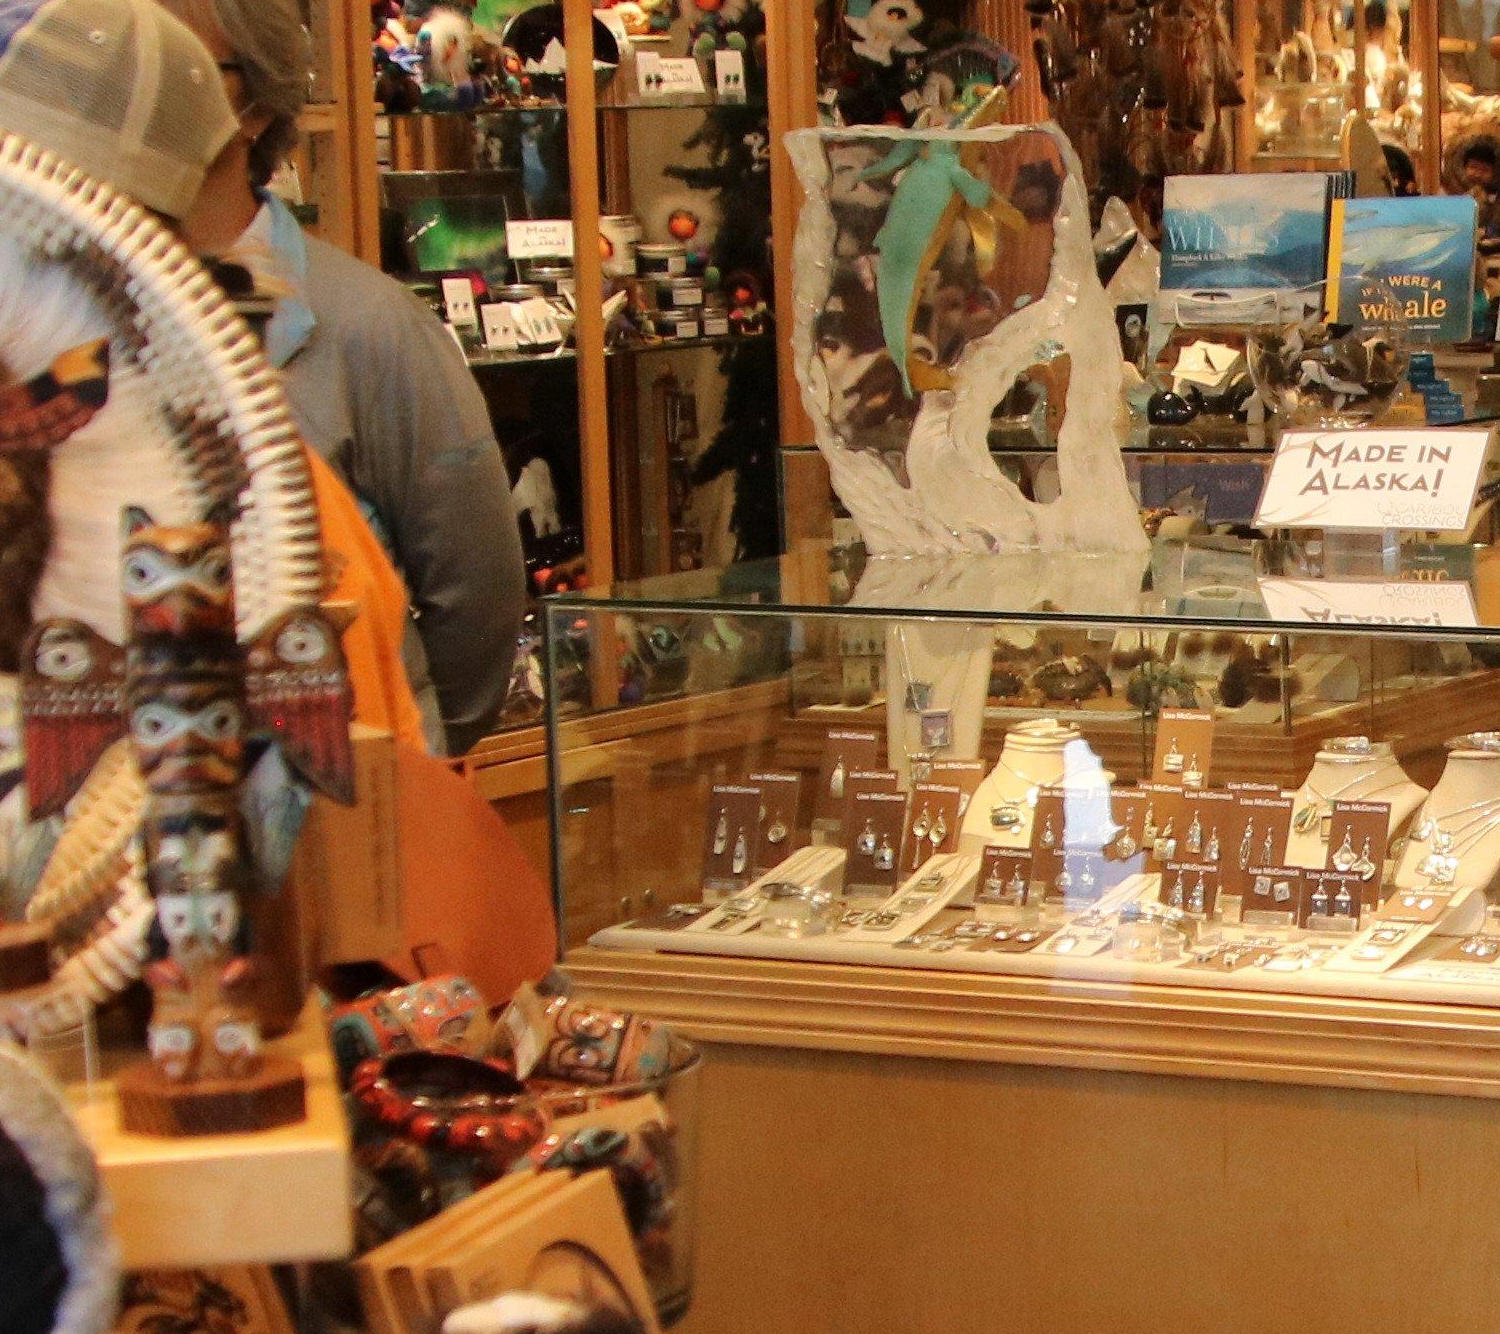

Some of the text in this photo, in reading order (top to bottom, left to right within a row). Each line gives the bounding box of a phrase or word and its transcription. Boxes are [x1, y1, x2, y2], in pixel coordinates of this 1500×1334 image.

[1388, 275, 1430, 288] WERE
[1432, 279, 1442, 291] A
[1305, 439, 1452, 469] MADE IN
[1297, 467, 1445, 498] ALASKA!
[1381, 513, 1465, 527] CROSSINGS
[1163, 712, 1211, 721] Lisa McCormick
[1241, 782, 1278, 791] McCormick
[1198, 791, 1234, 801] McCormick
[1254, 797, 1291, 807] McCormick
[1181, 862, 1218, 872] McCormick
[1263, 867, 1300, 877] McCormick
